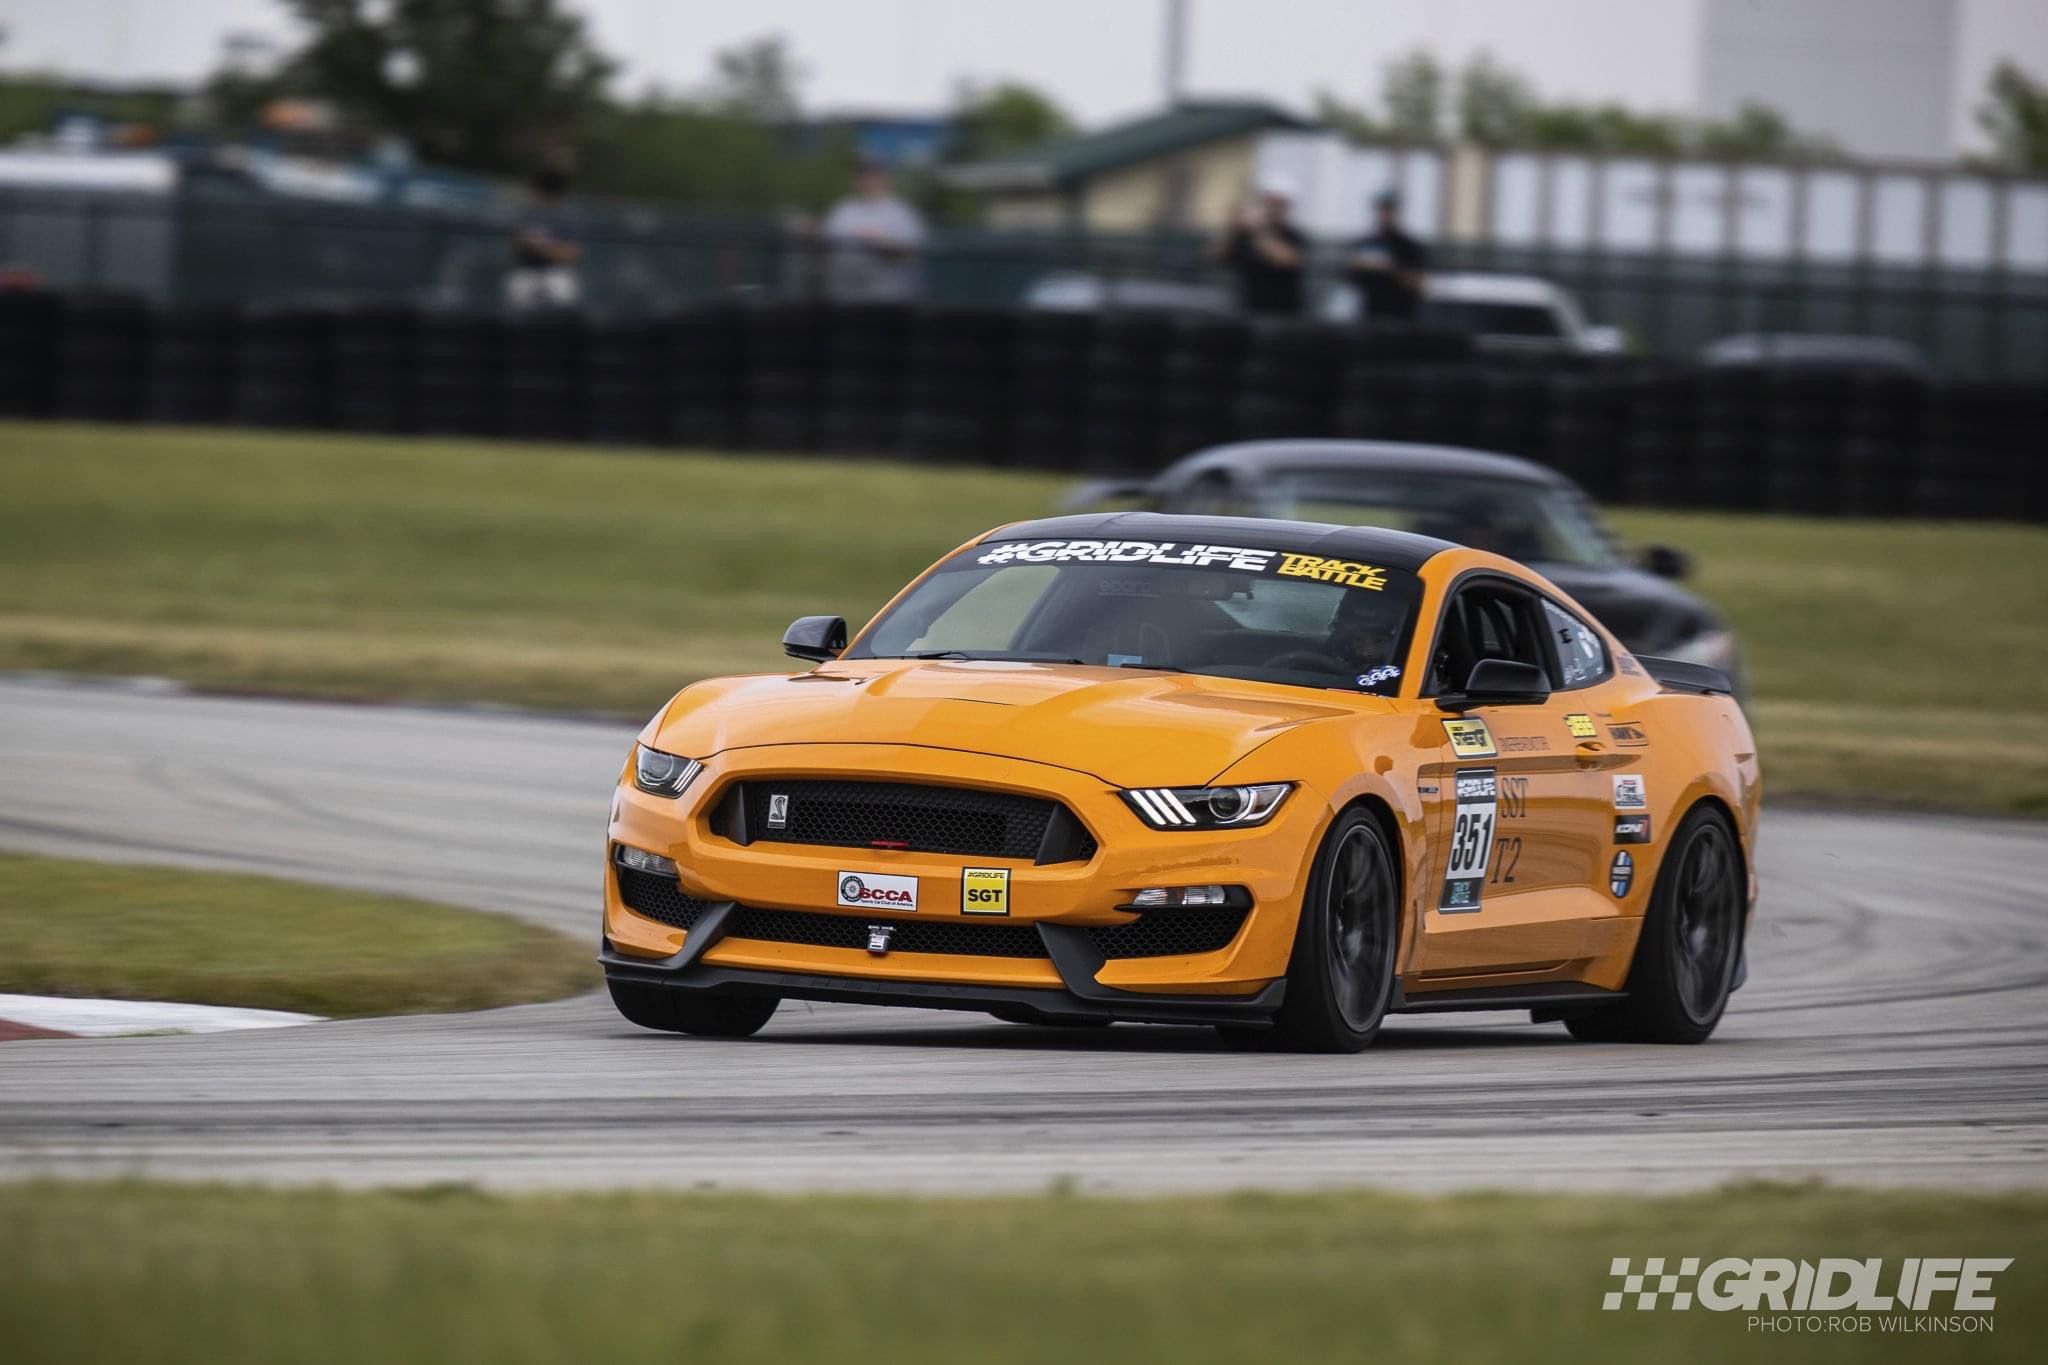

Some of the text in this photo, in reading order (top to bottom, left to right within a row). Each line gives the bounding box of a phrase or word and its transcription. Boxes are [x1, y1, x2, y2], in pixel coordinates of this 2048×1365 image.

[976, 541, 1278, 571] #GRIDLIFE
[1280, 552, 1387, 577] TRACK
[1276, 564, 1388, 592] BATTLE
[1501, 776, 1528, 818] SST
[1450, 813, 1493, 872] 351
[1490, 837, 1523, 884] T2
[860, 887, 913, 903] SCCA
[968, 889, 1003, 903] SGT
